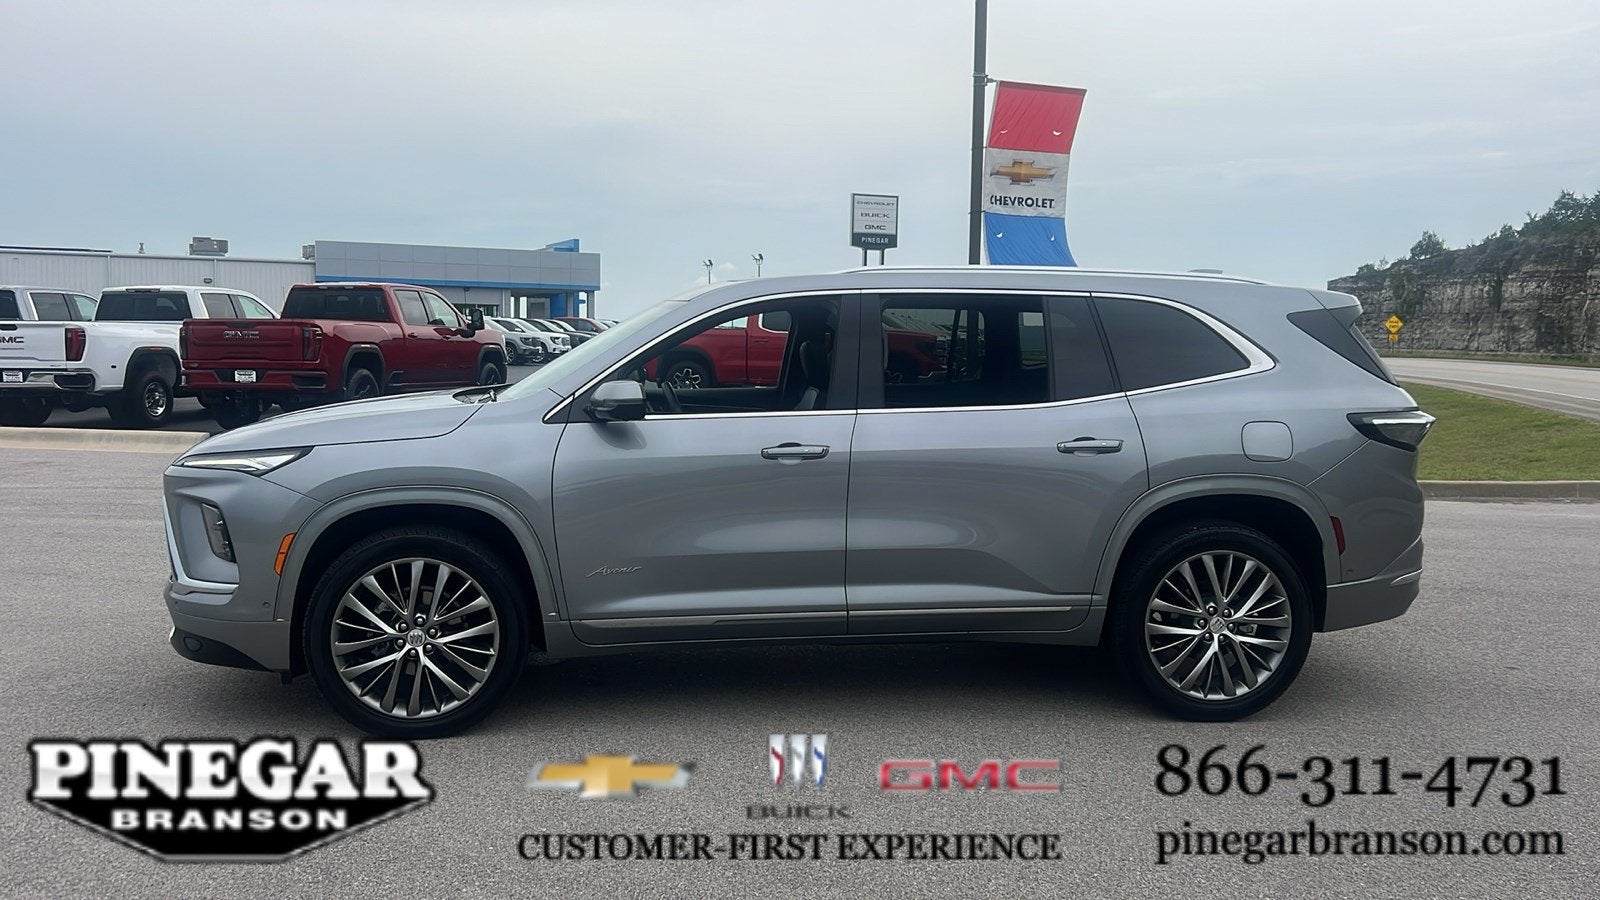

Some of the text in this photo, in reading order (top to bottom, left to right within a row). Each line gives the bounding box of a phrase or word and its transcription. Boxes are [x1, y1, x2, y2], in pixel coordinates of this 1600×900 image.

[989, 195, 1055, 209] CHEVROLET
[861, 236, 889, 244] PINEGAR
[0, 336, 25, 344] MC
